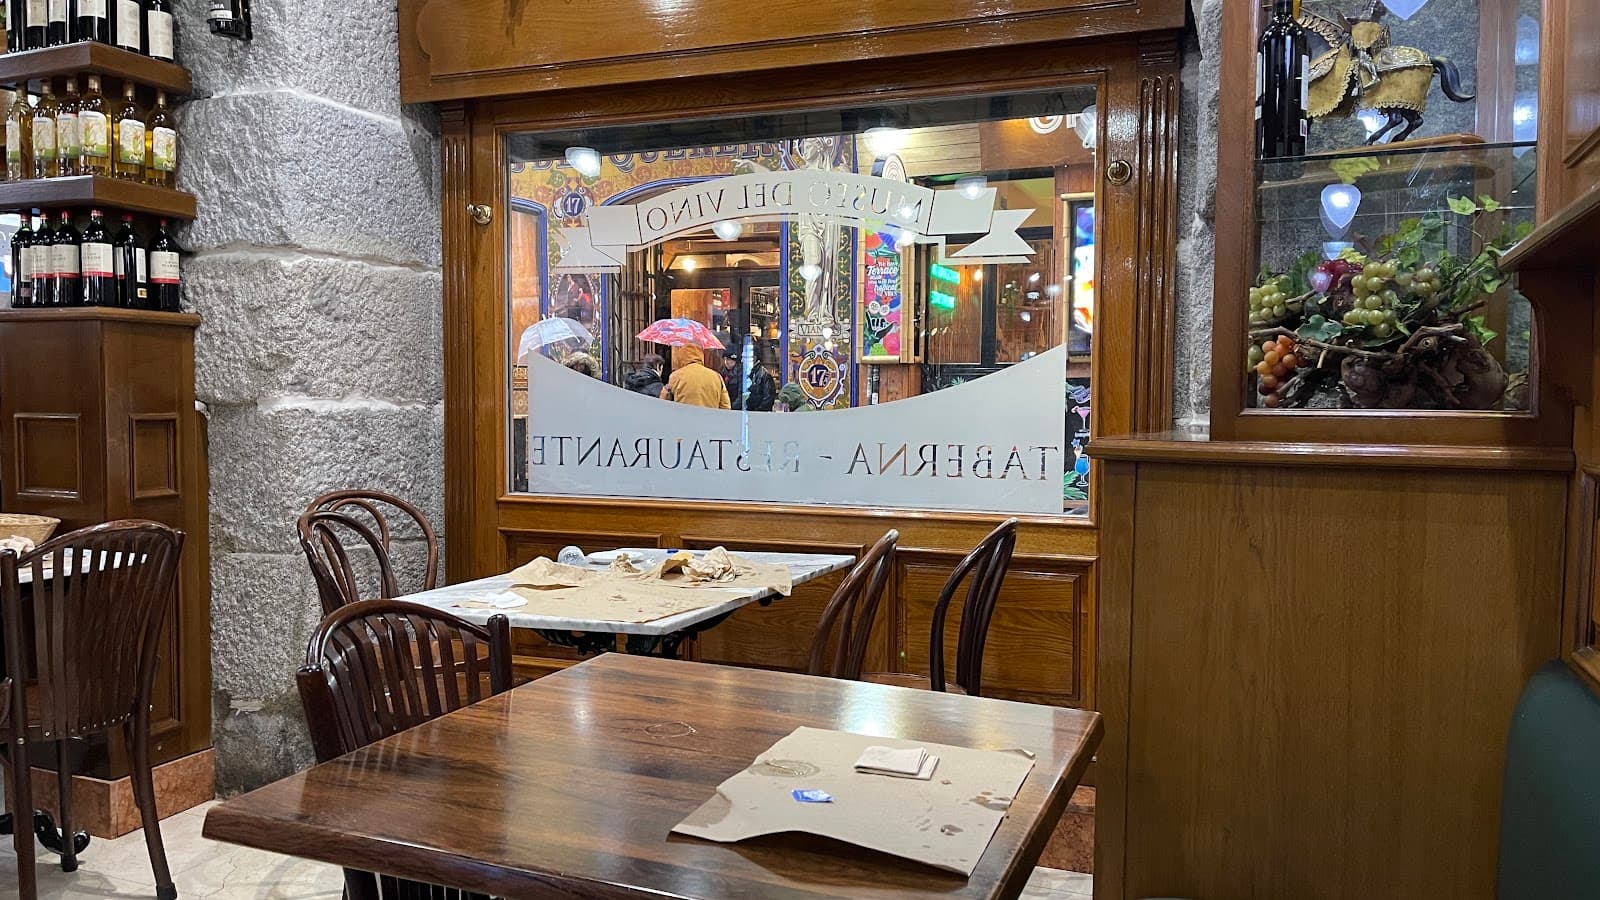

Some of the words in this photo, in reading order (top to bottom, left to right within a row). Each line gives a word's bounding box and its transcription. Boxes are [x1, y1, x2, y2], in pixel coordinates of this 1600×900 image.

[566, 196, 581, 214] 17
[867, 265, 898, 276] Terrace
[810, 367, 827, 386] 17
